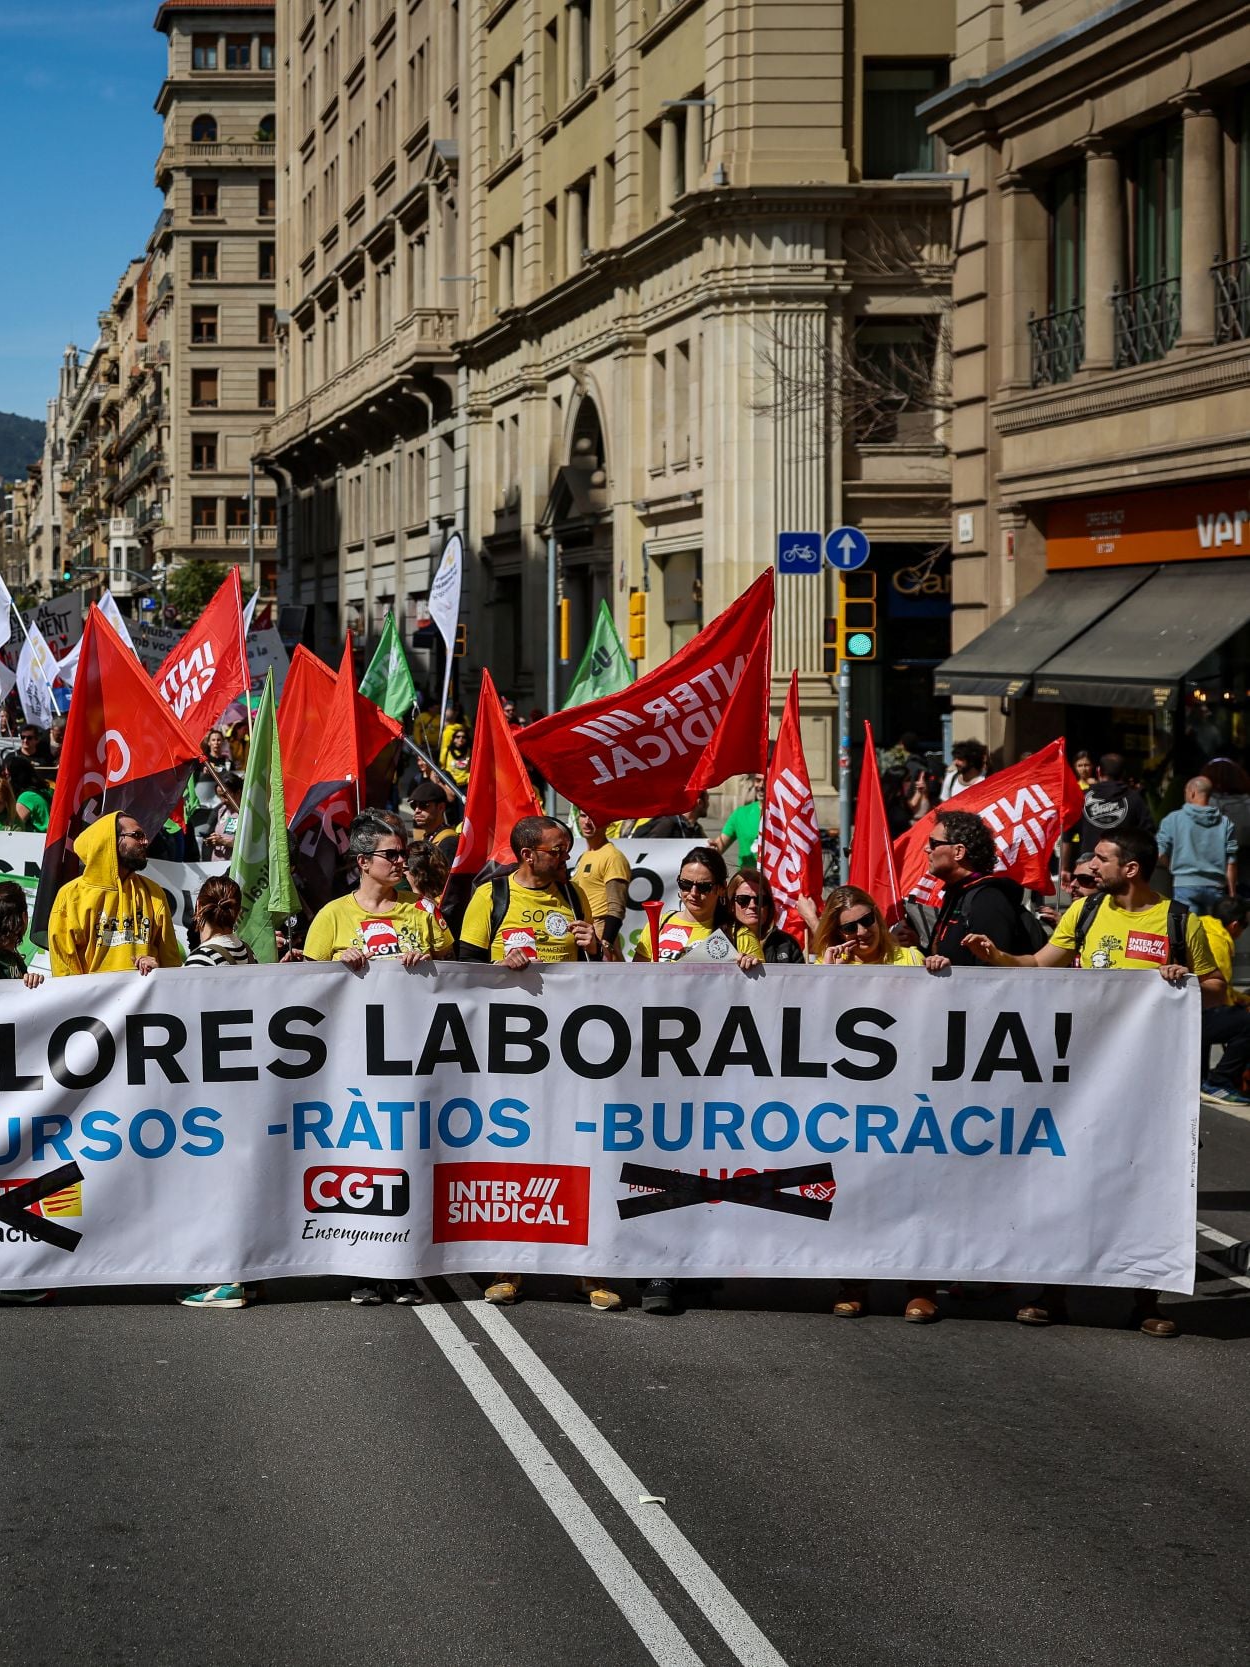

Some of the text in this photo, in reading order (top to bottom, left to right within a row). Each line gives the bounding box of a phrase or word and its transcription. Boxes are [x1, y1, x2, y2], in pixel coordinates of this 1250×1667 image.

[370, 943, 397, 955] CGT
[1127, 944, 1166, 956] SINDICAL
[1129, 937, 1153, 947] INTER
[365, 1002, 898, 1083] LABORALS
[931, 1010, 1073, 1083] JA!
[267, 1088, 532, 1151] -RÀTIOS
[575, 1093, 1067, 1158] -BUROCRÀCIA
[310, 1171, 403, 1211] CGT
[448, 1179, 522, 1203] INTER
[448, 1202, 570, 1226] SINDICAL
[301, 1218, 412, 1247] Ensenyament
